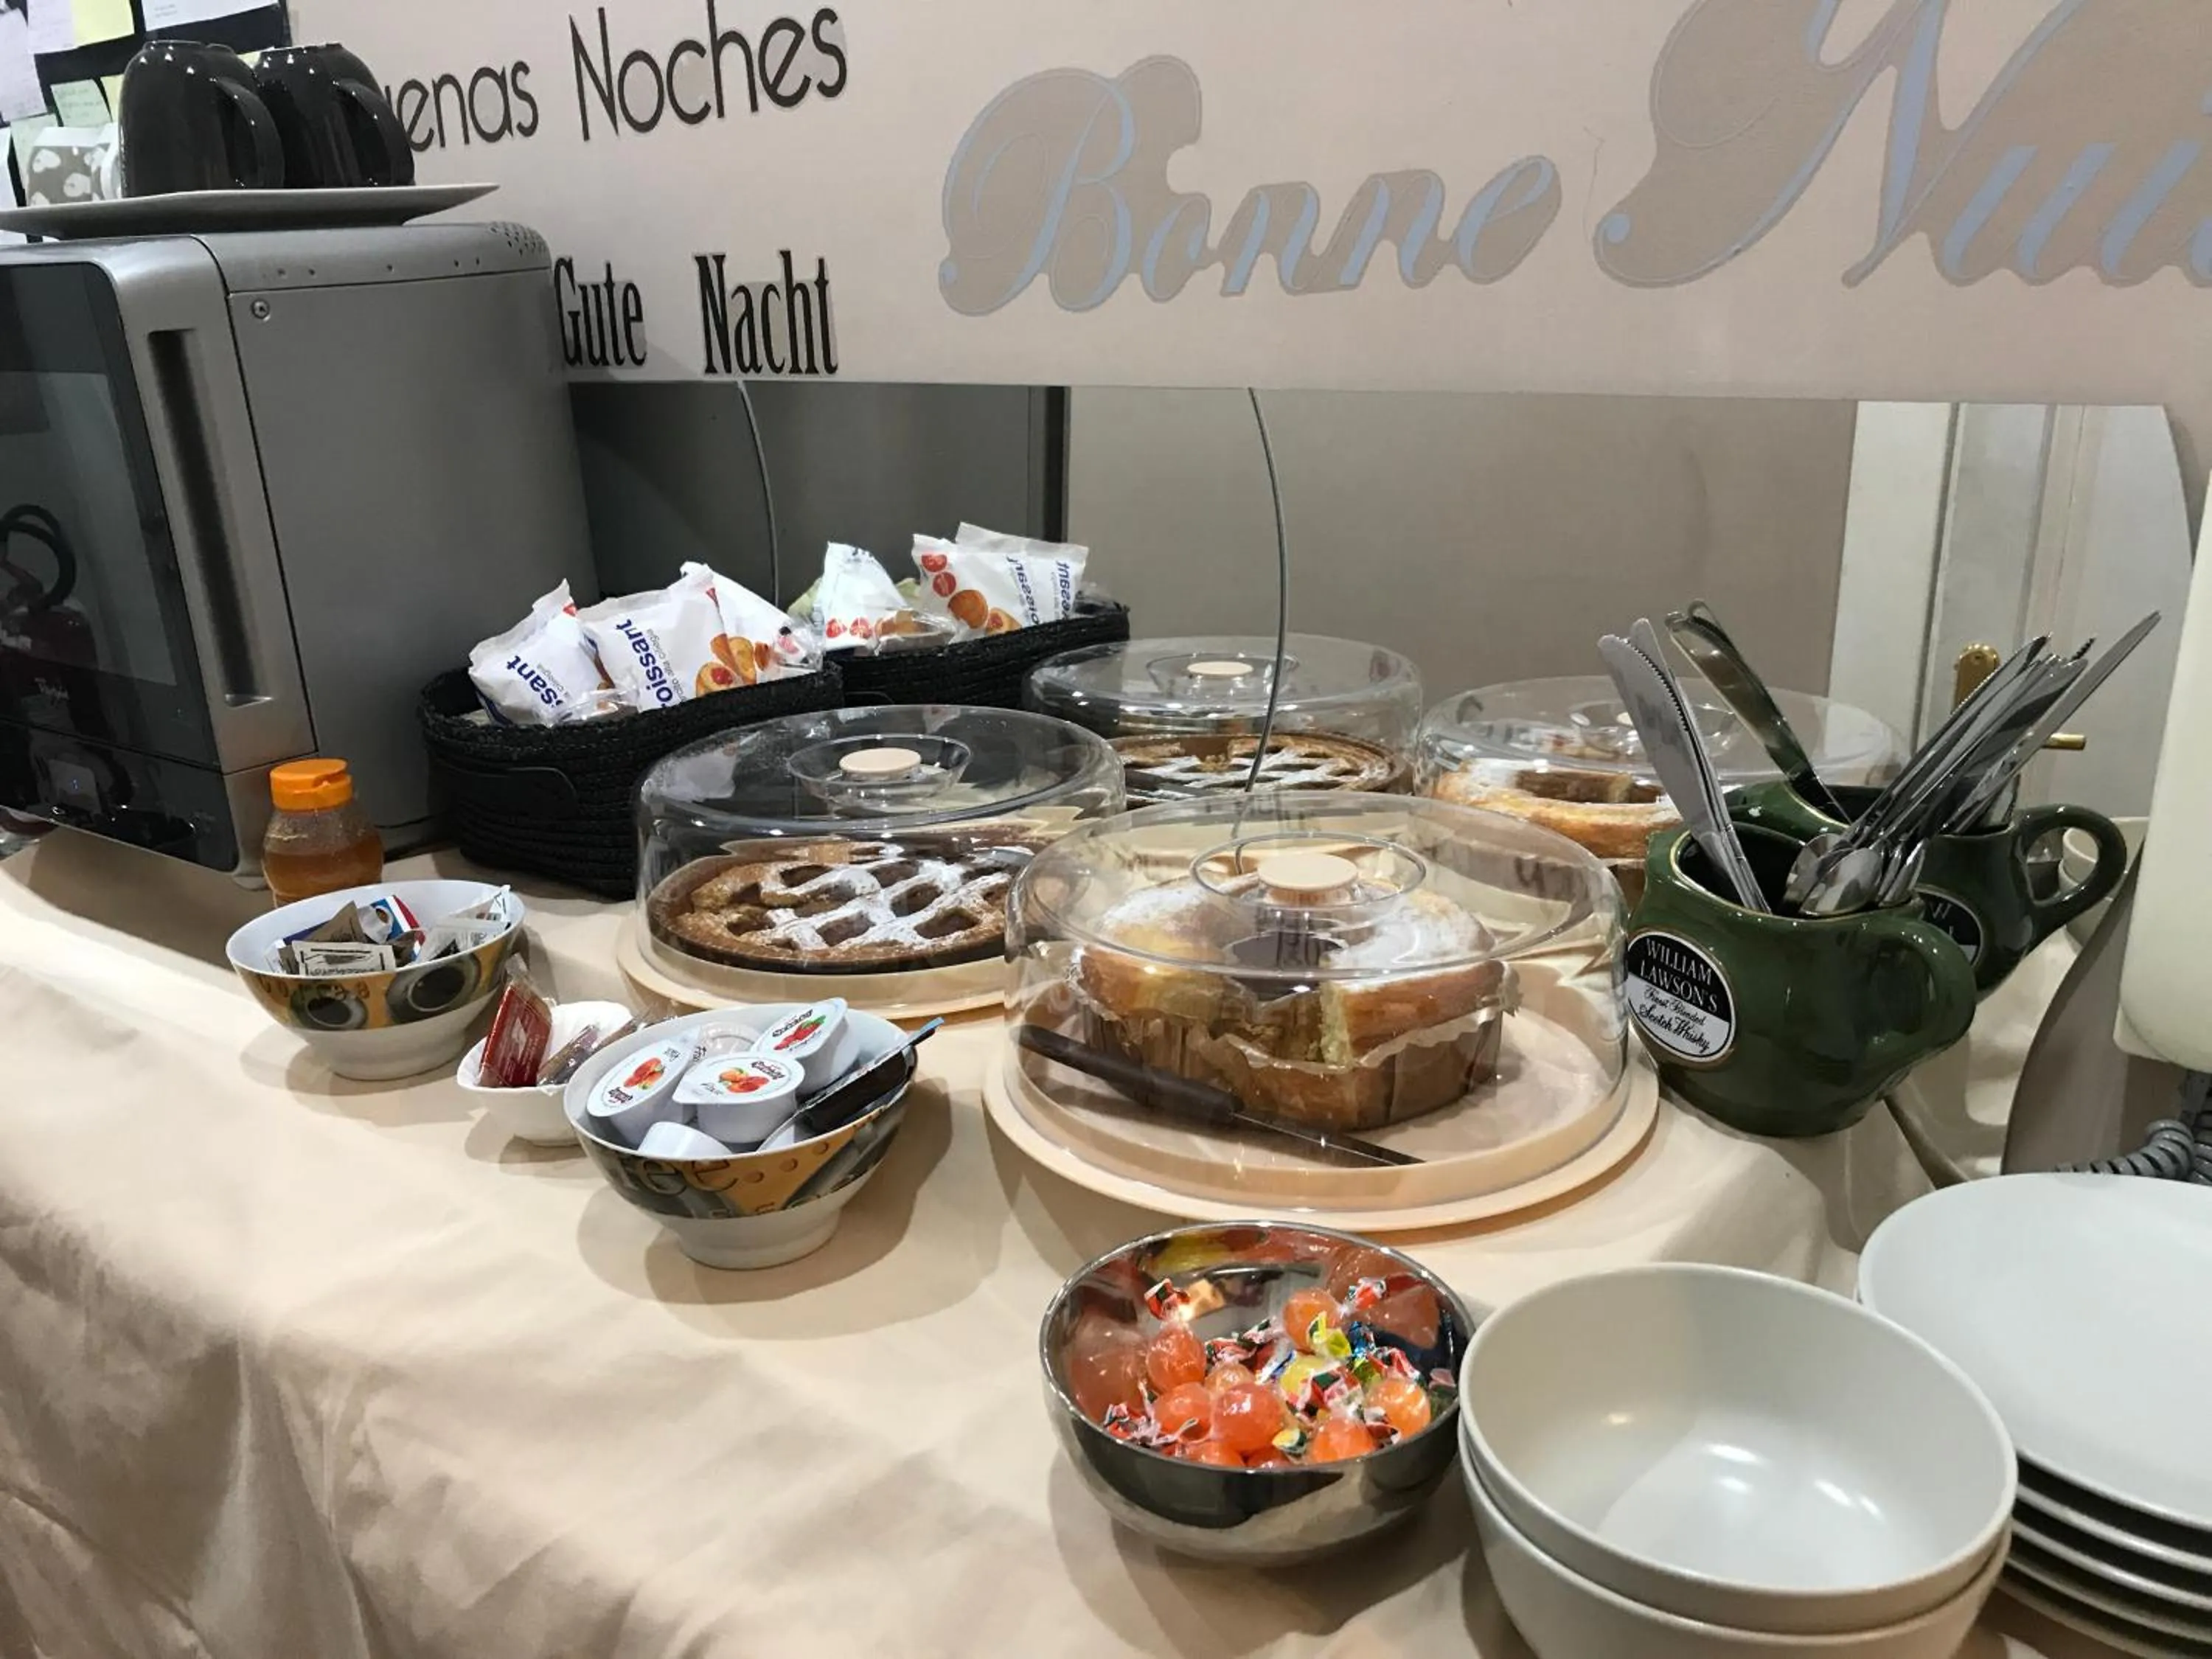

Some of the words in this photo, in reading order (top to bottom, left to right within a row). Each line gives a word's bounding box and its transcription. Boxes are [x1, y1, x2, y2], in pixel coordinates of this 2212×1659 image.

[385, 60, 539, 152] enas
[568, 0, 848, 142] Noches
[939, 54, 1562, 316] Bonne
[554, 255, 647, 368] Gute
[694, 249, 838, 375] Nacht
[507, 655, 563, 708] sant
[616, 617, 673, 707] oissant
[1641, 959, 1717, 1014] LAWSON'S
[1646, 937, 1711, 986] WILLIAM
